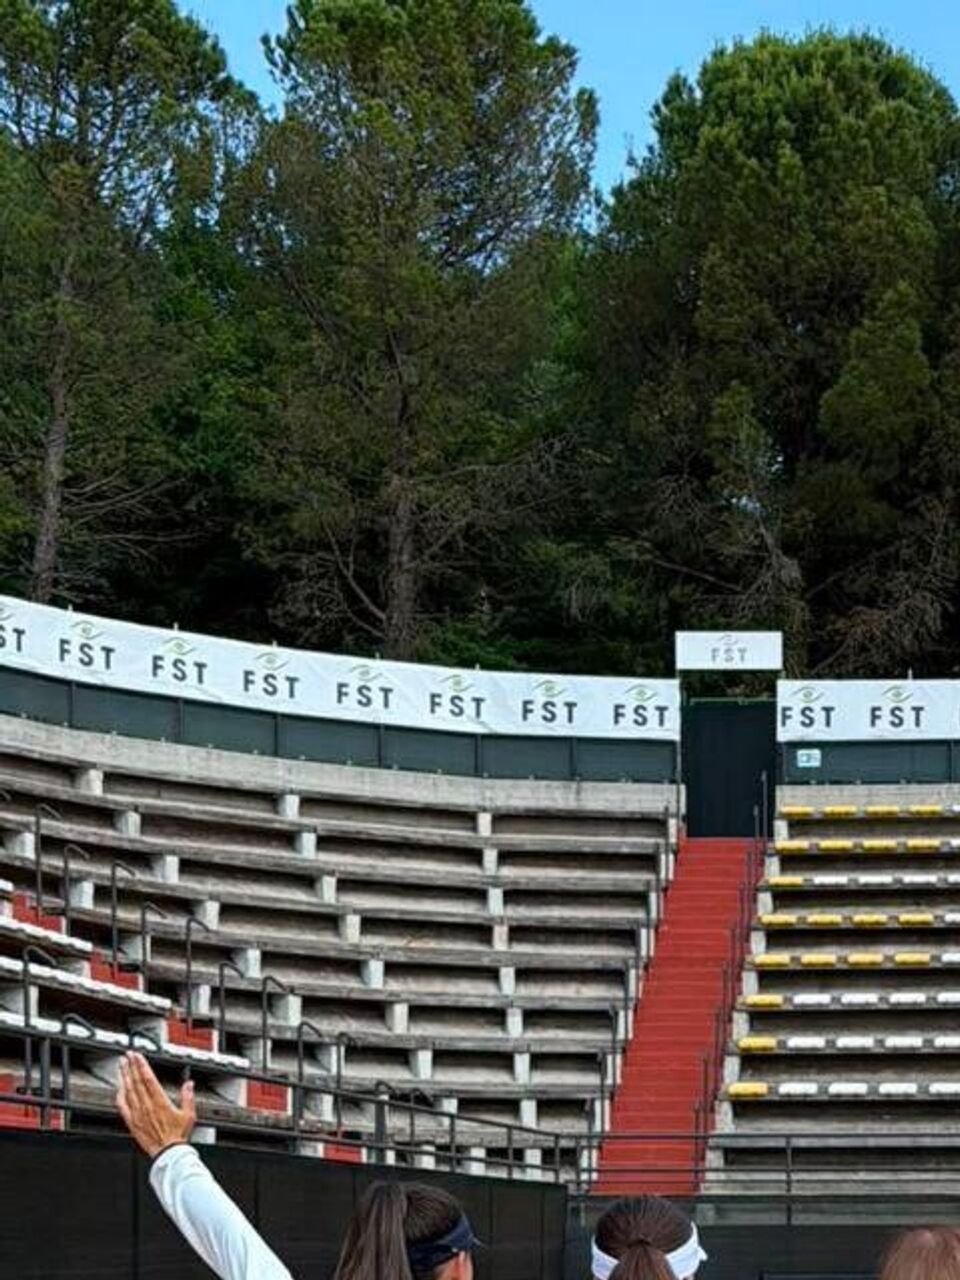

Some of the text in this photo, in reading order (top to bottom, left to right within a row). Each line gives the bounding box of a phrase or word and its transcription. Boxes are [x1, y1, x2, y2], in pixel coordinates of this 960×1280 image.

[710, 646, 748, 663] FST
[59, 638, 115, 670] FST
[152, 655, 207, 684] FST
[243, 670, 299, 699] FST
[336, 682, 394, 709] FST
[429, 692, 485, 719] FST
[522, 699, 578, 724] FST
[613, 703, 669, 727] FST
[781, 706, 835, 728] FST
[870, 706, 925, 728] FST
